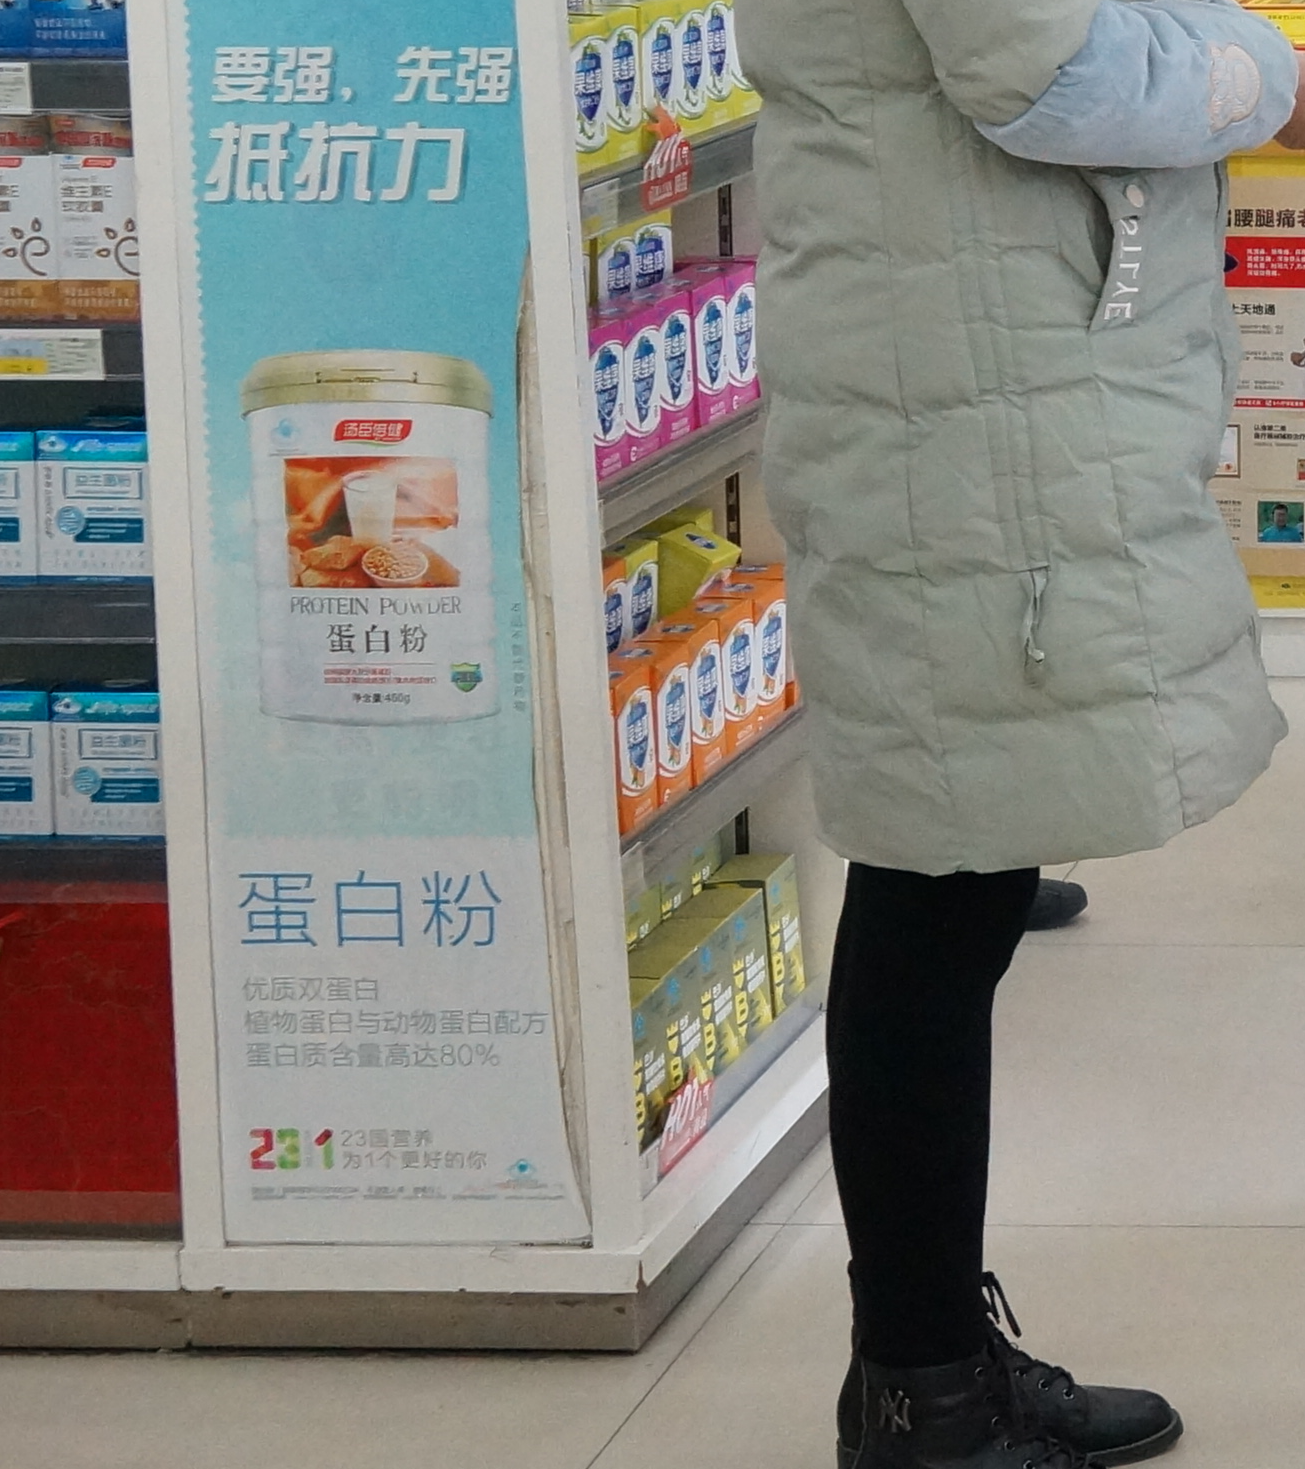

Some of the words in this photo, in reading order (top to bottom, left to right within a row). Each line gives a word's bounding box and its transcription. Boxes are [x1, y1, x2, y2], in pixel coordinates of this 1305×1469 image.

[204, 121, 466, 203] 抵抗力
[290, 596, 370, 615] PROTEIN
[380, 595, 462, 615] POWDER
[326, 624, 428, 654] 蛋白粉
[238, 869, 502, 948] 蛋白粉
[242, 976, 379, 1002] 优质双蛋白
[243, 1009, 549, 1035] 植物蛋白与动物蛋白配方
[245, 1043, 501, 1069] 蛋白质含量高达80%
[340, 1128, 434, 1149] 23国营养
[341, 1150, 488, 1171] 为1个更好的你
